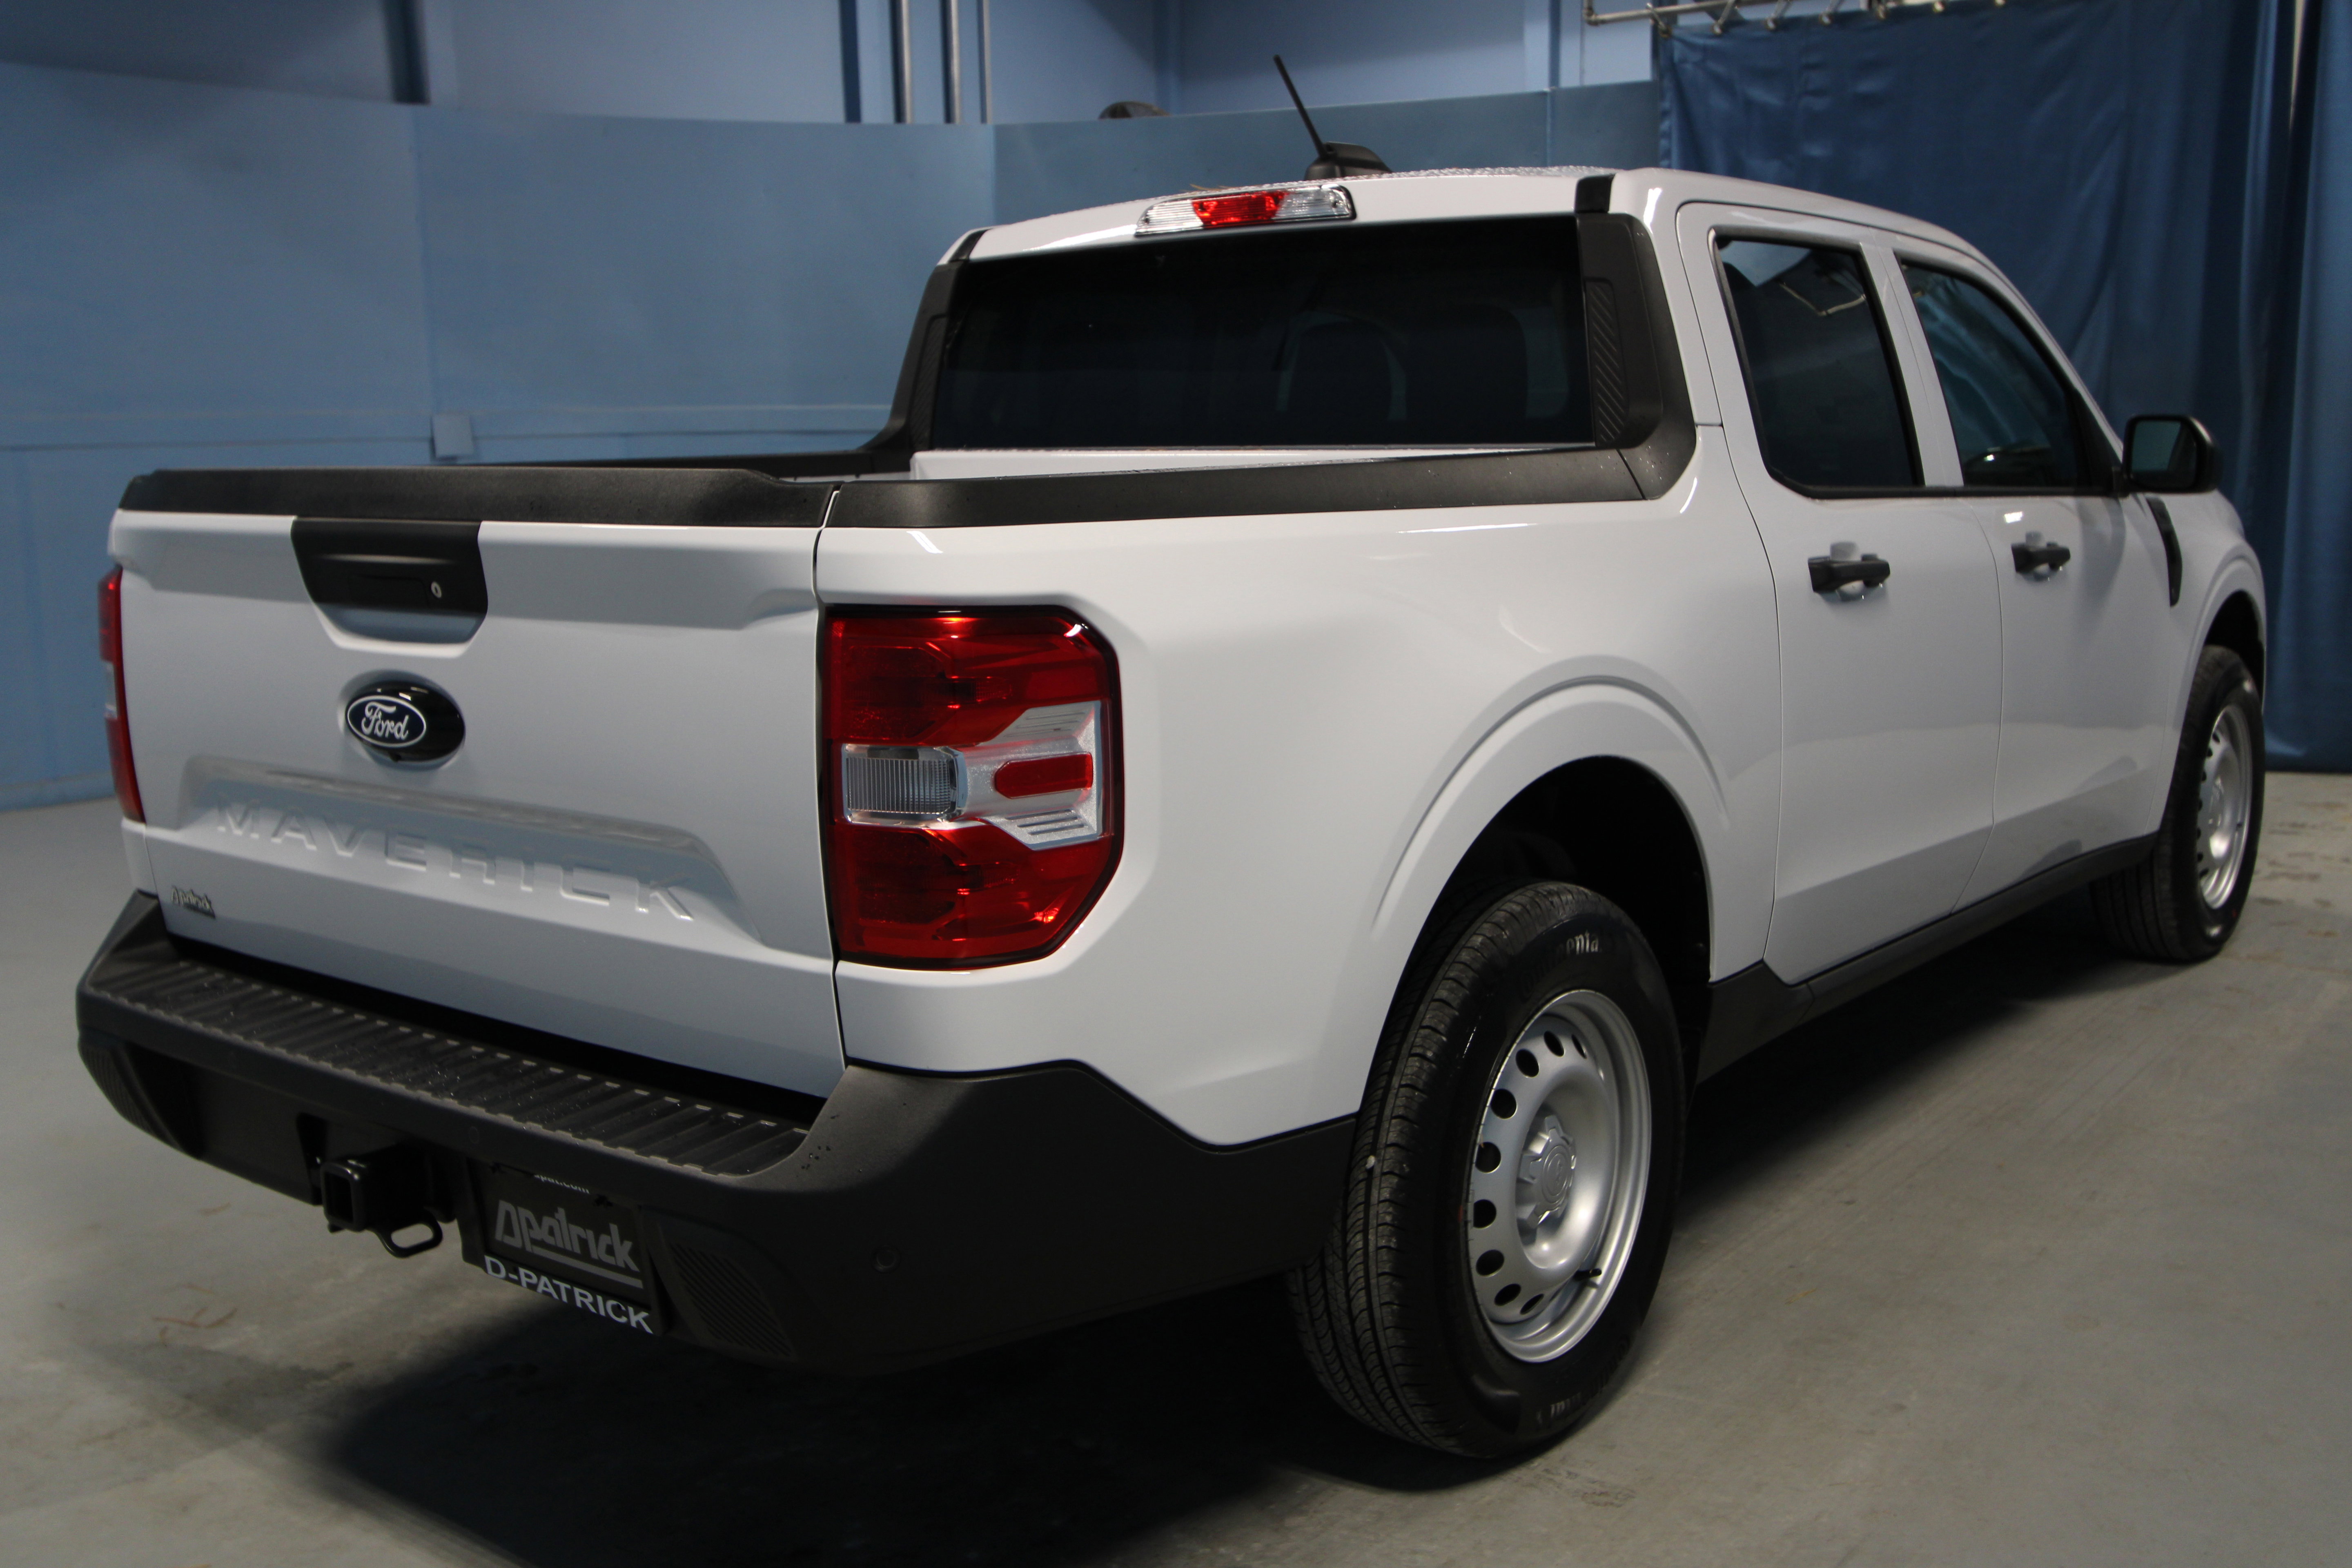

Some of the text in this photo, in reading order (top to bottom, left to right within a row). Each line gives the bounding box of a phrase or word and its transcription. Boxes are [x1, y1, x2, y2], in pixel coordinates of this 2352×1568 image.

[361, 702, 409, 740] Ford
[216, 799, 693, 921] MAVERICK
[484, 1255, 653, 1334] D-PATRICK
